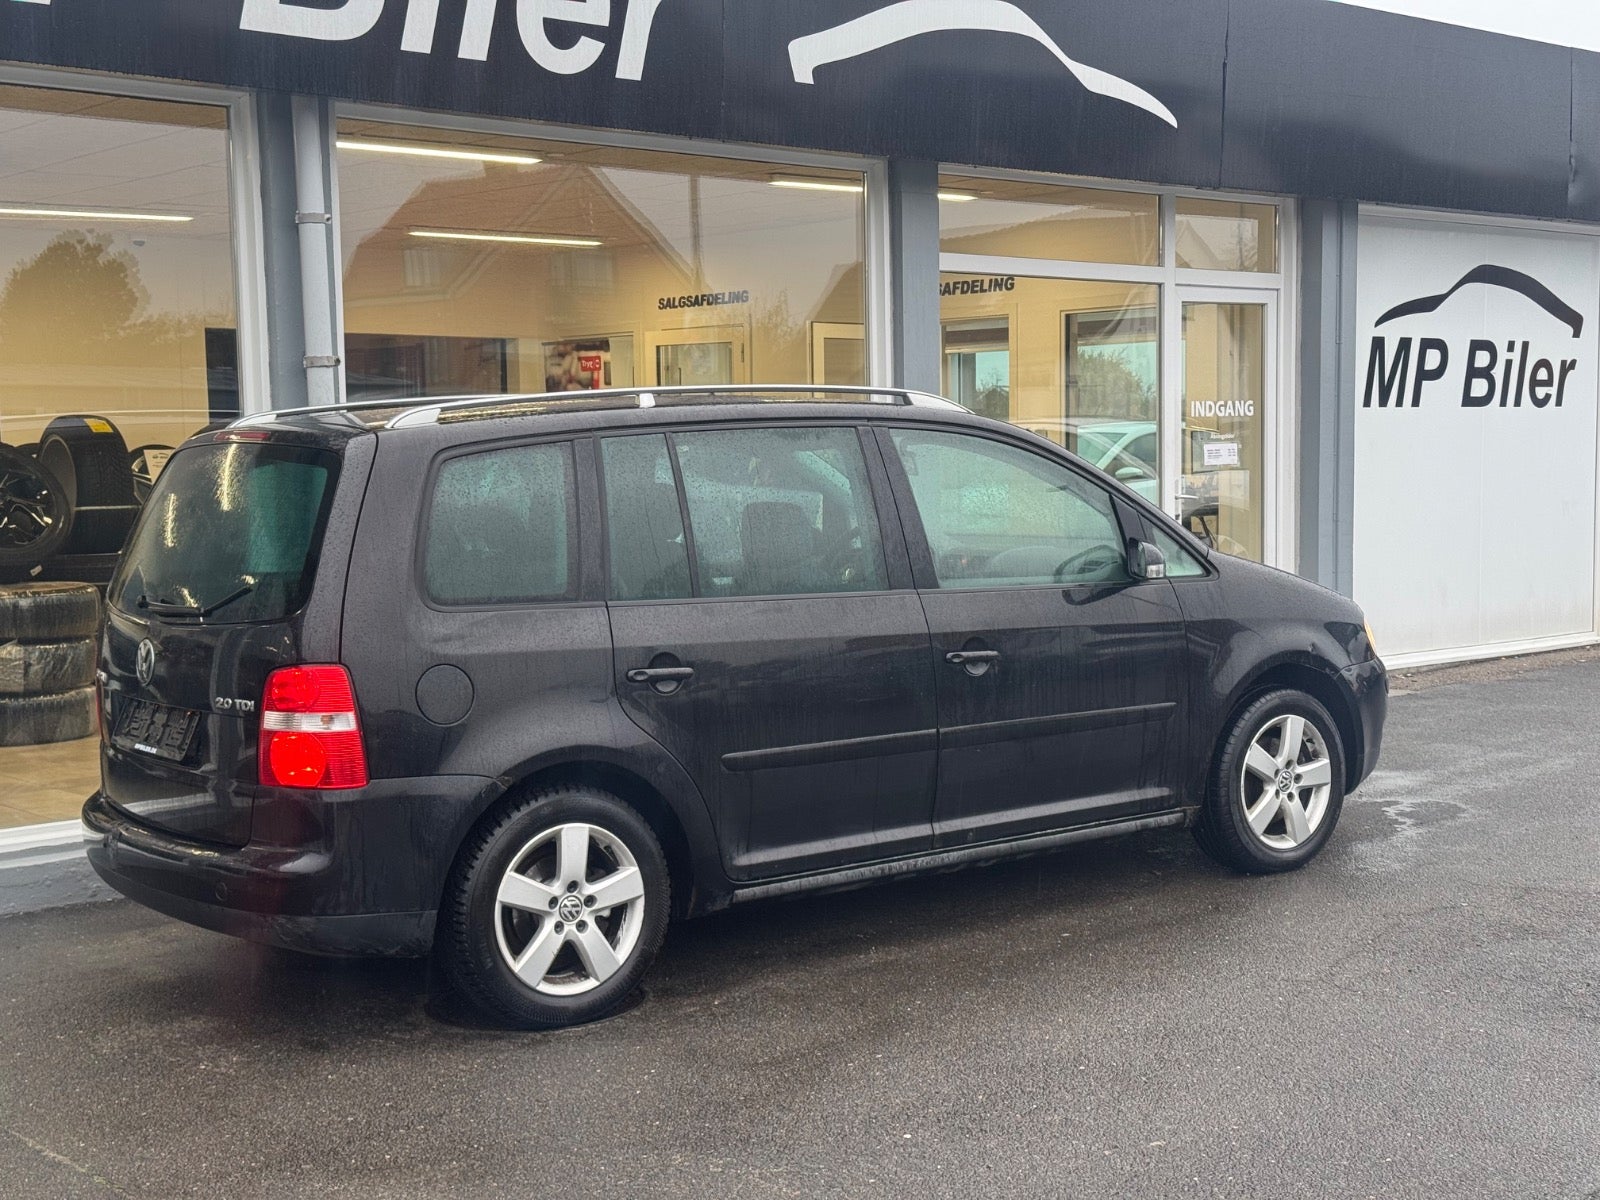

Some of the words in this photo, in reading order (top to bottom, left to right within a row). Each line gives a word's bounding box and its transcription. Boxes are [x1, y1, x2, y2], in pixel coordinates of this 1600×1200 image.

[658, 289, 749, 310] SALGSAFDELING
[1362, 336, 1449, 408] MP
[1461, 339, 1577, 408] Biler
[1190, 400, 1254, 417] INDGANG
[234, 698, 255, 711] TDI
